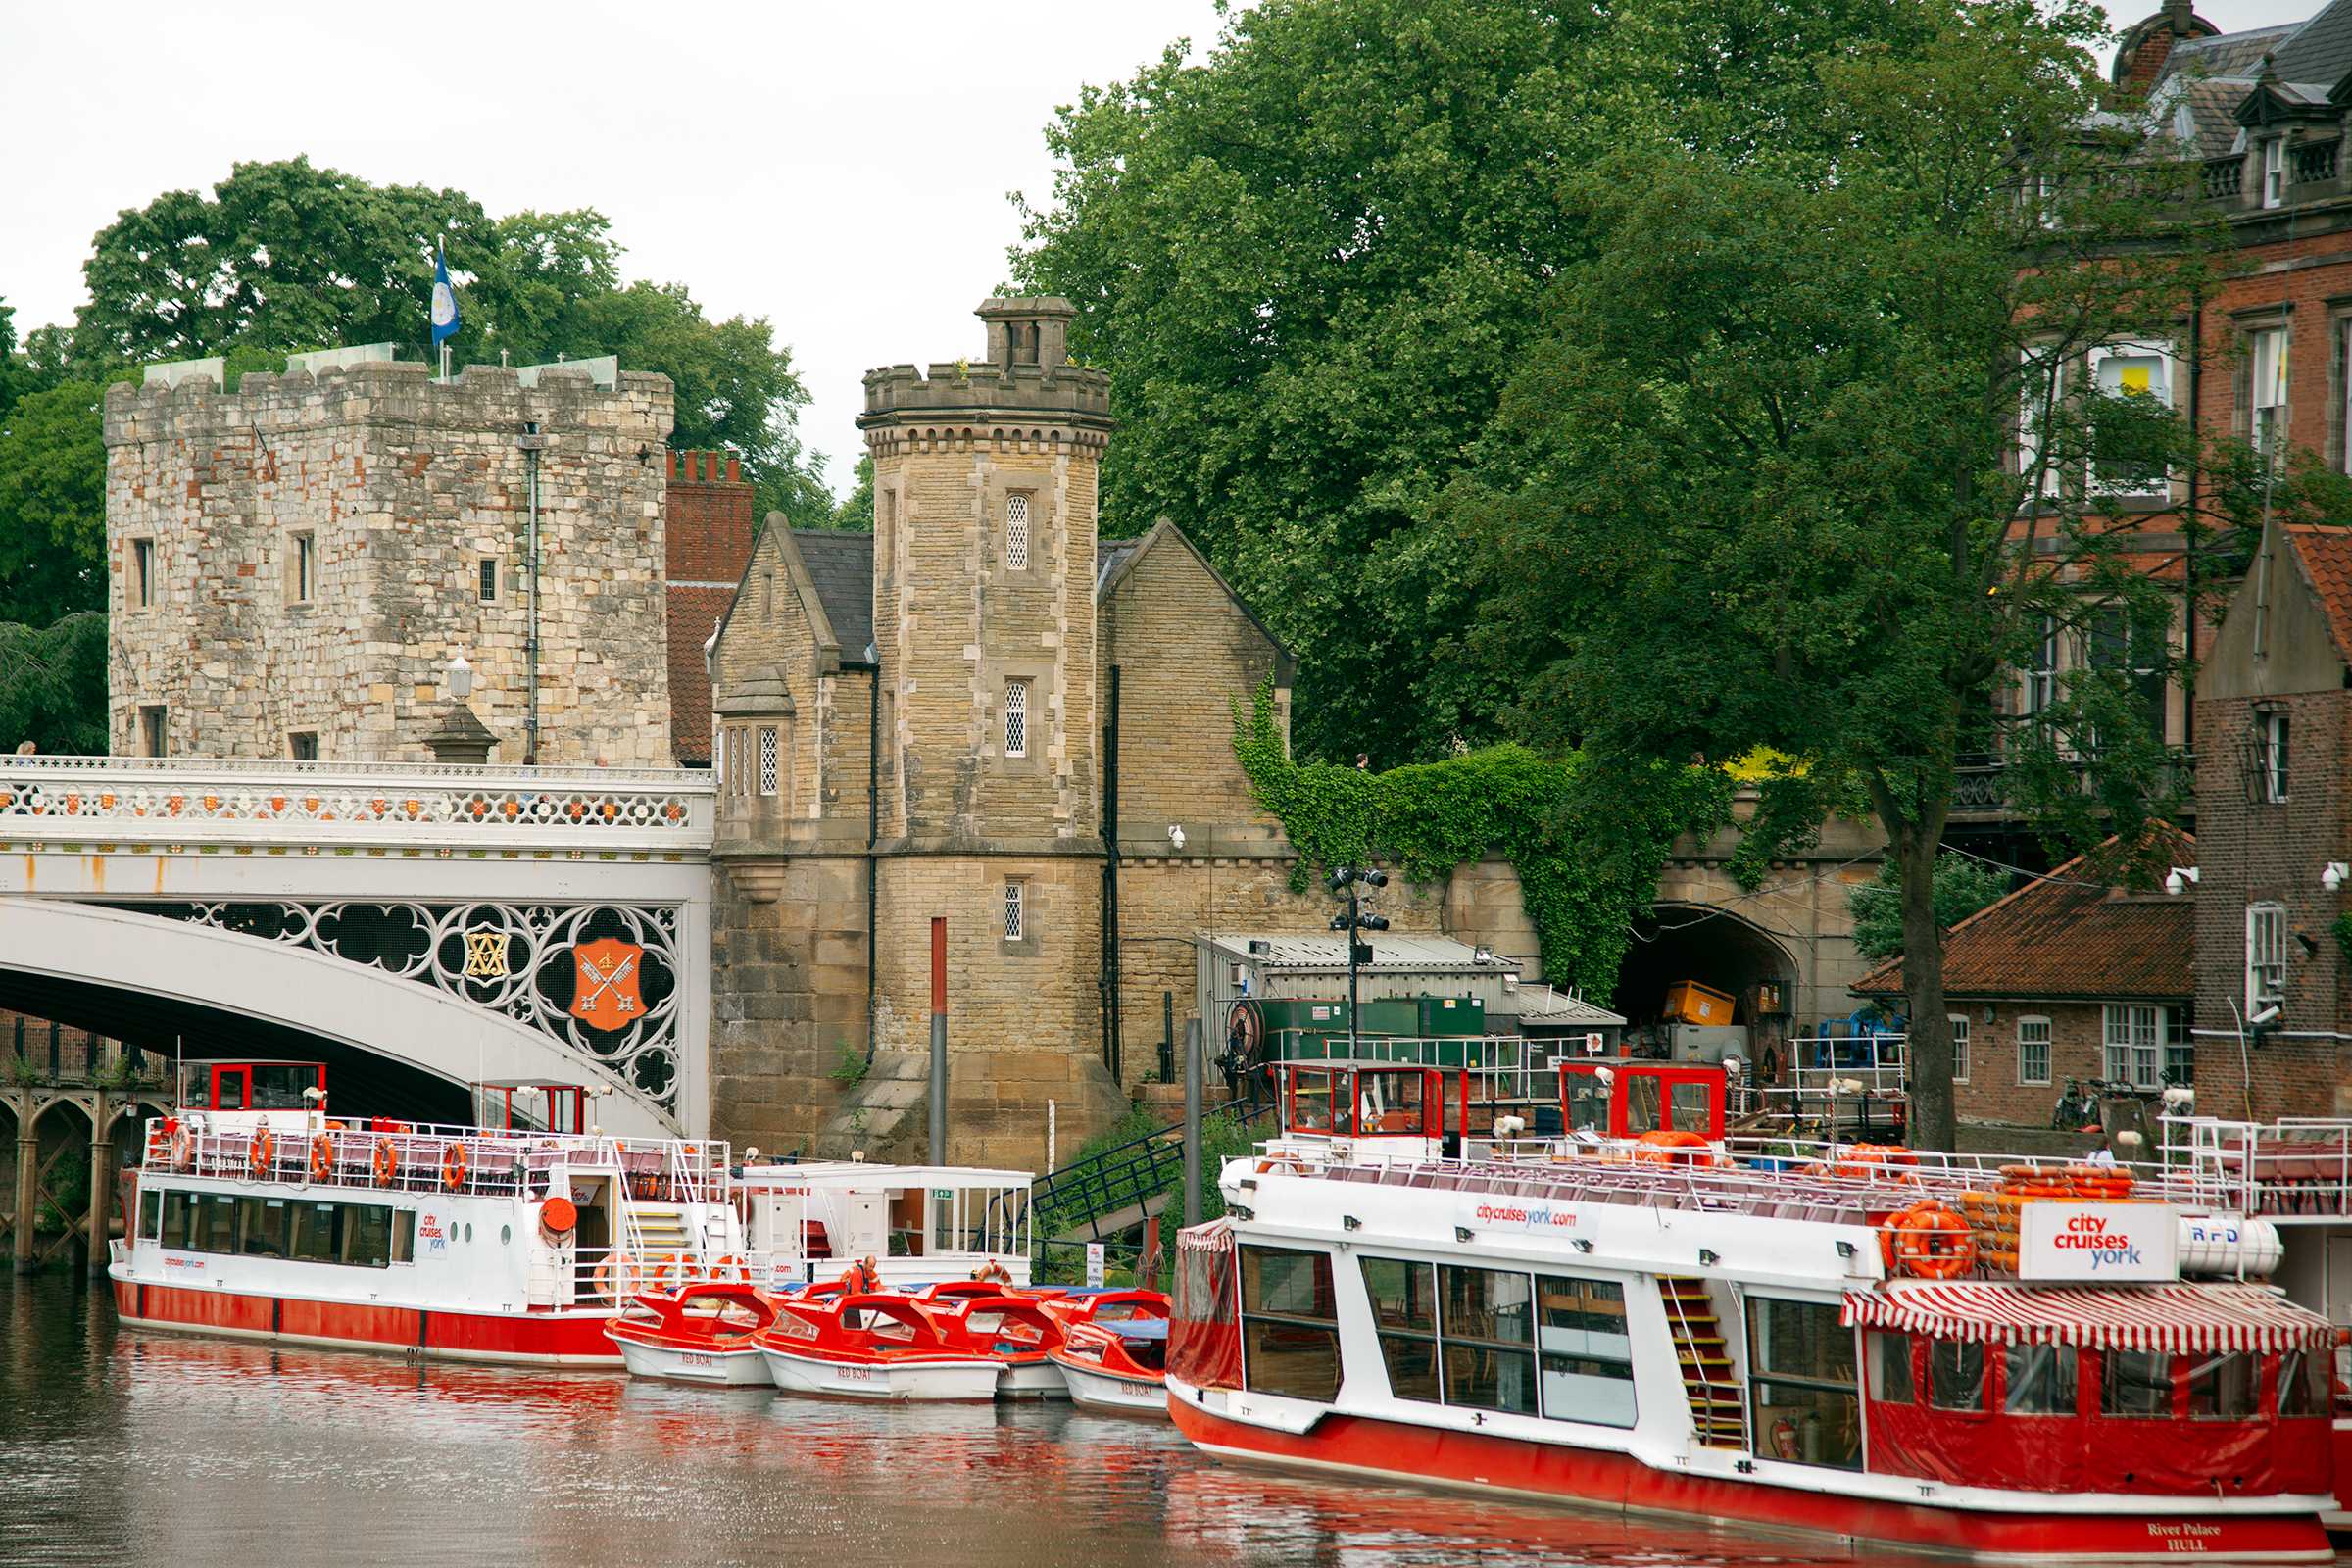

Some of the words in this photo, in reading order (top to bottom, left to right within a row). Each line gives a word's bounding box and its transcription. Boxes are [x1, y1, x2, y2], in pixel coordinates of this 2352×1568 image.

[423, 1213, 437, 1227] city
[1477, 1202, 1577, 1228] citycruisesyork.com
[2068, 1213, 2107, 1233] city
[419, 1226, 442, 1238] cruises
[430, 1237, 445, 1252] york
[2054, 1233, 2128, 1250] cruises
[2091, 1244, 2141, 1270] york
[681, 1352, 694, 1364] RED
[696, 1354, 712, 1367] BOAT
[837, 1365, 851, 1378] RED
[852, 1367, 871, 1380] BOAT
[2147, 1523, 2180, 1536] River
[2183, 1523, 2221, 1536] Palace
[2167, 1539, 2207, 1552] HULL
